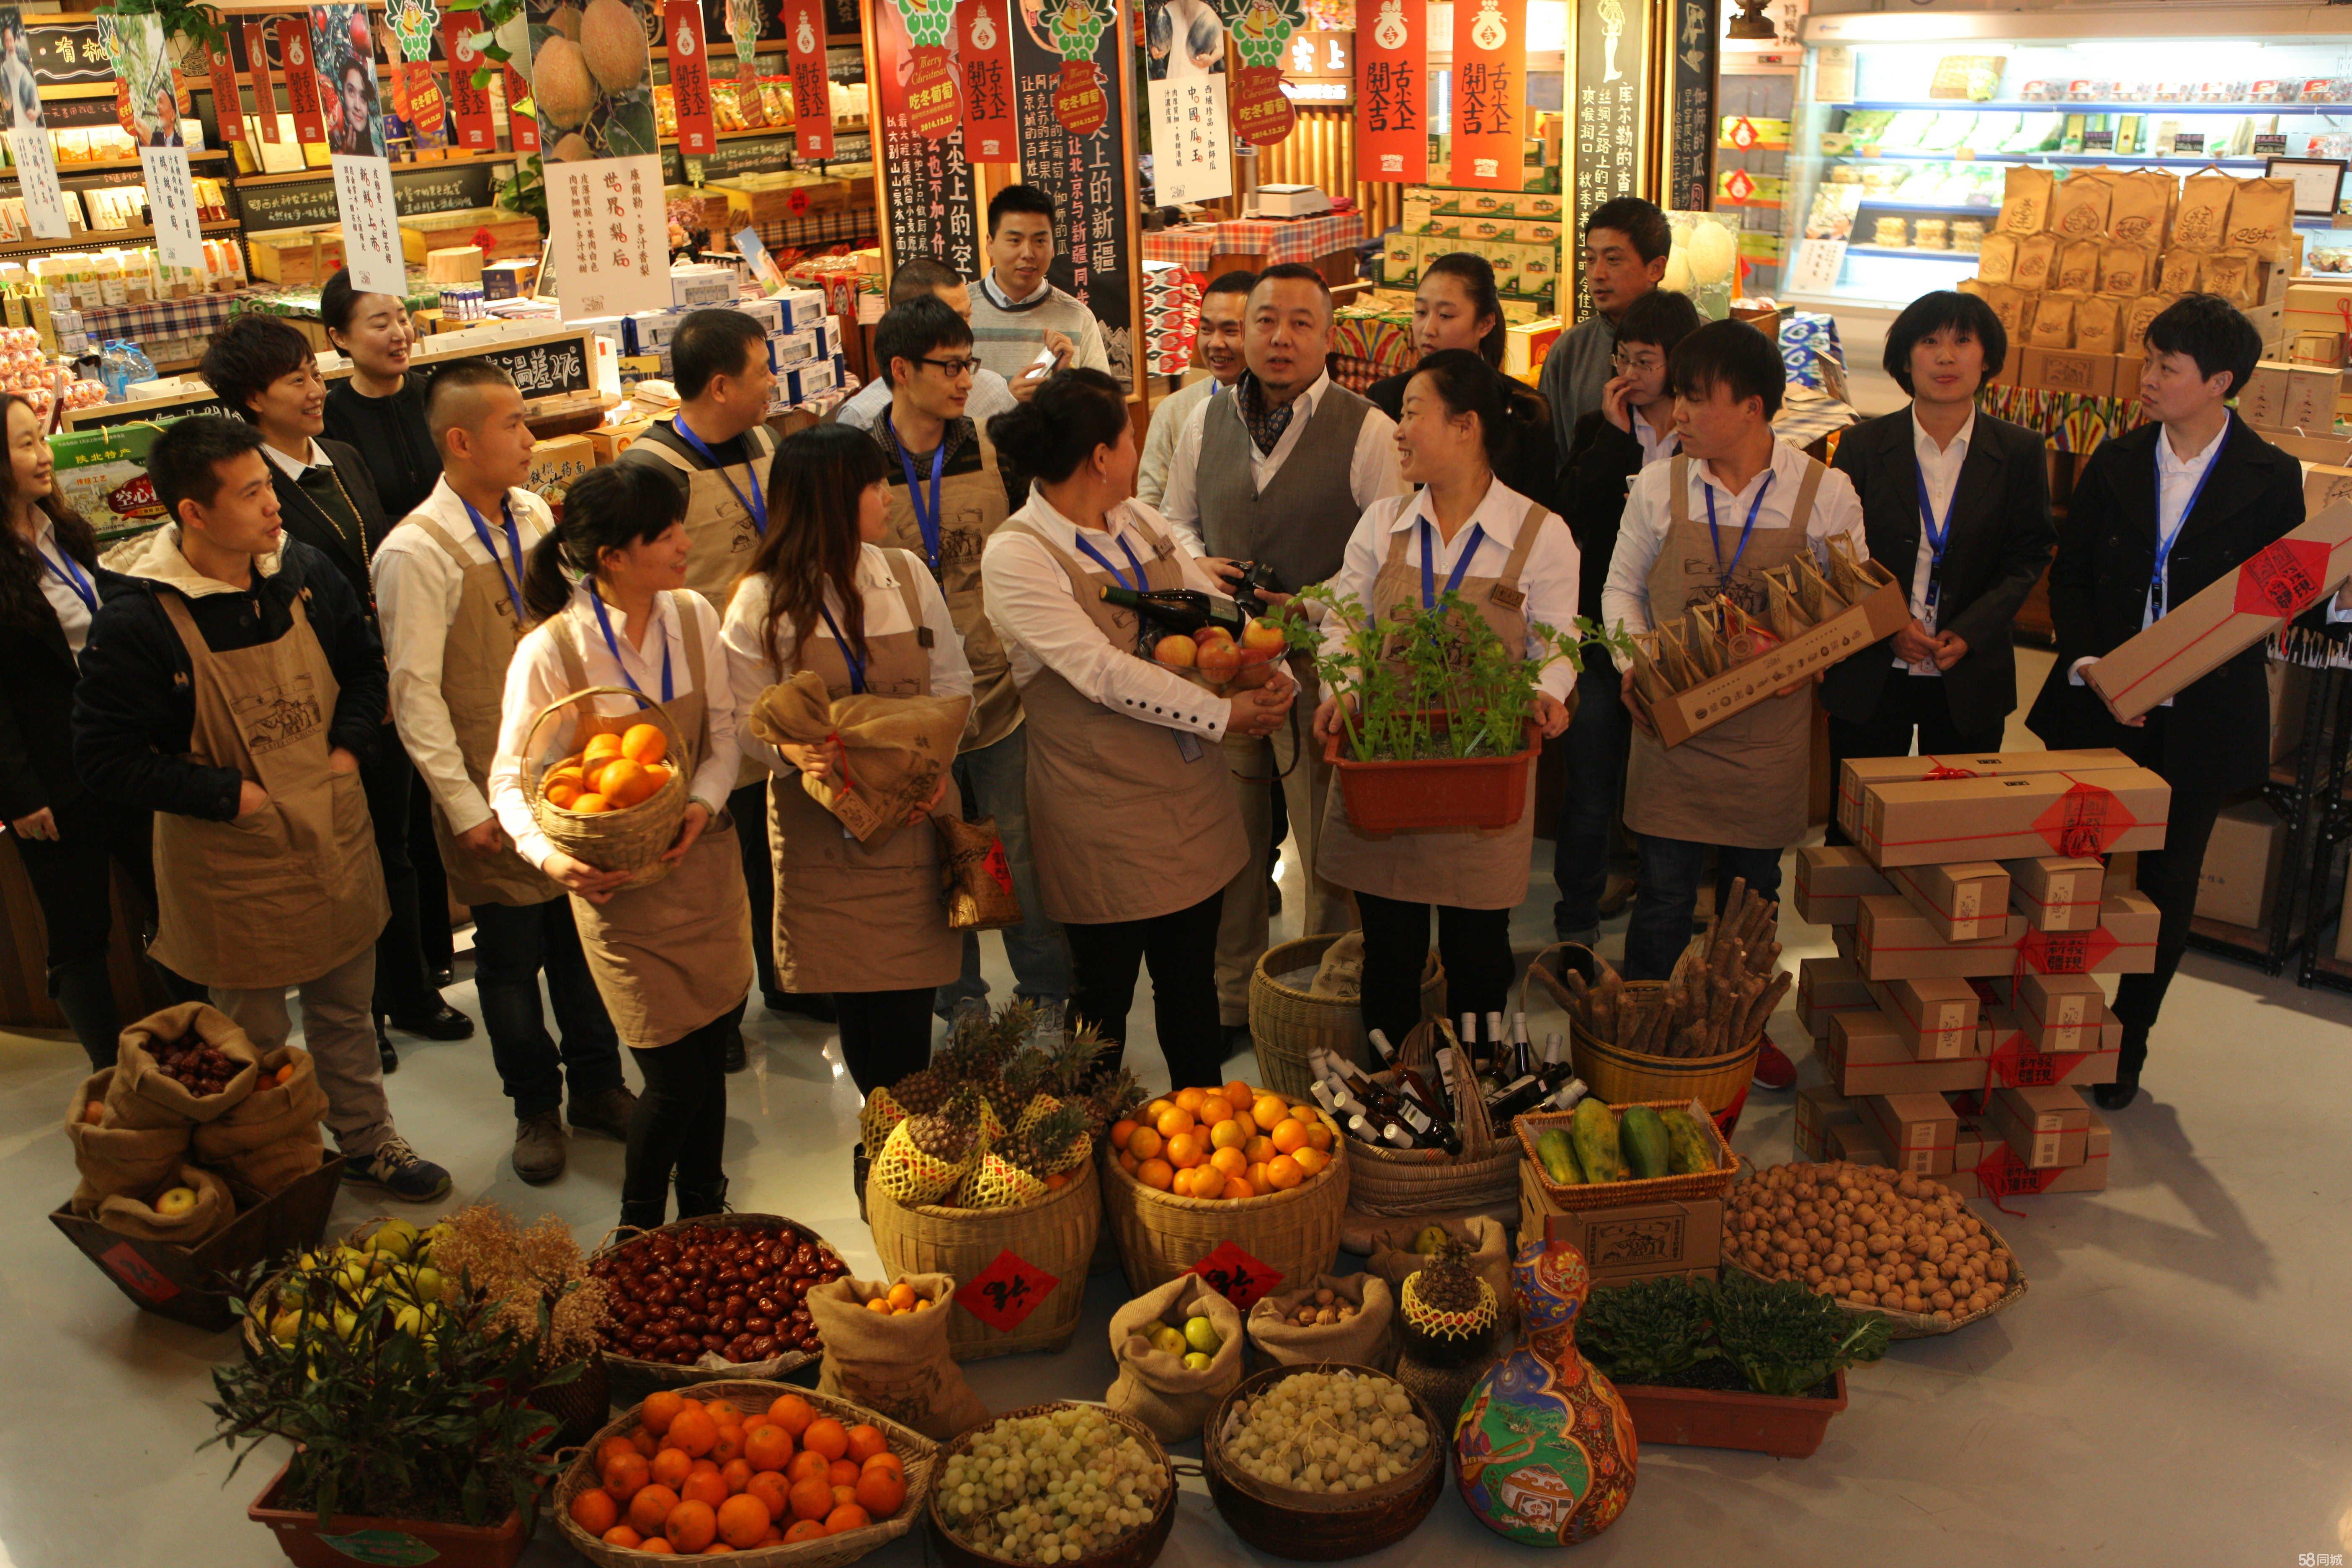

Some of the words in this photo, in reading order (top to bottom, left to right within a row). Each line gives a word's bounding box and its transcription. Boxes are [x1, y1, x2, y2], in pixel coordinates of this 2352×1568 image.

[1292, 36, 1345, 72] 尖上
[1385, 28, 1396, 41] 吉
[1483, 28, 1494, 41] 吉
[911, 67, 946, 85] Christmas
[919, 55, 941, 69] Merry
[1252, 76, 1276, 86] Merry
[410, 87, 438, 111] 吃冬葡萄
[467, 69, 486, 115] 尖上
[909, 81, 953, 110] 吃冬葡萄
[968, 61, 987, 121] 開大吉
[986, 59, 1007, 119] 舌尖上
[1059, 89, 1099, 111] 吃冬葡萄
[1240, 97, 1287, 121] 吃冬葡萄
[1366, 62, 1392, 132] 開大吉
[1390, 60, 1416, 131] 舌尖上
[1462, 62, 1487, 135] 開大吉
[1486, 62, 1513, 135] 舌尖上
[921, 115, 953, 132] 2014.12.25
[1188, 86, 1202, 162] 中國瓜王
[1615, 82, 1634, 198] 库尔勒的香
[1594, 88, 1612, 210] 丝绸之路上的西
[360, 166, 380, 252] 新鮮上市
[603, 171, 629, 267] 世界梨后
[927, 138, 945, 260] 么也不加，什
[946, 121, 973, 284] 舌尖上的空
[75, 448, 132, 464] 陕北特产
[77, 475, 107, 486] 传统工艺
